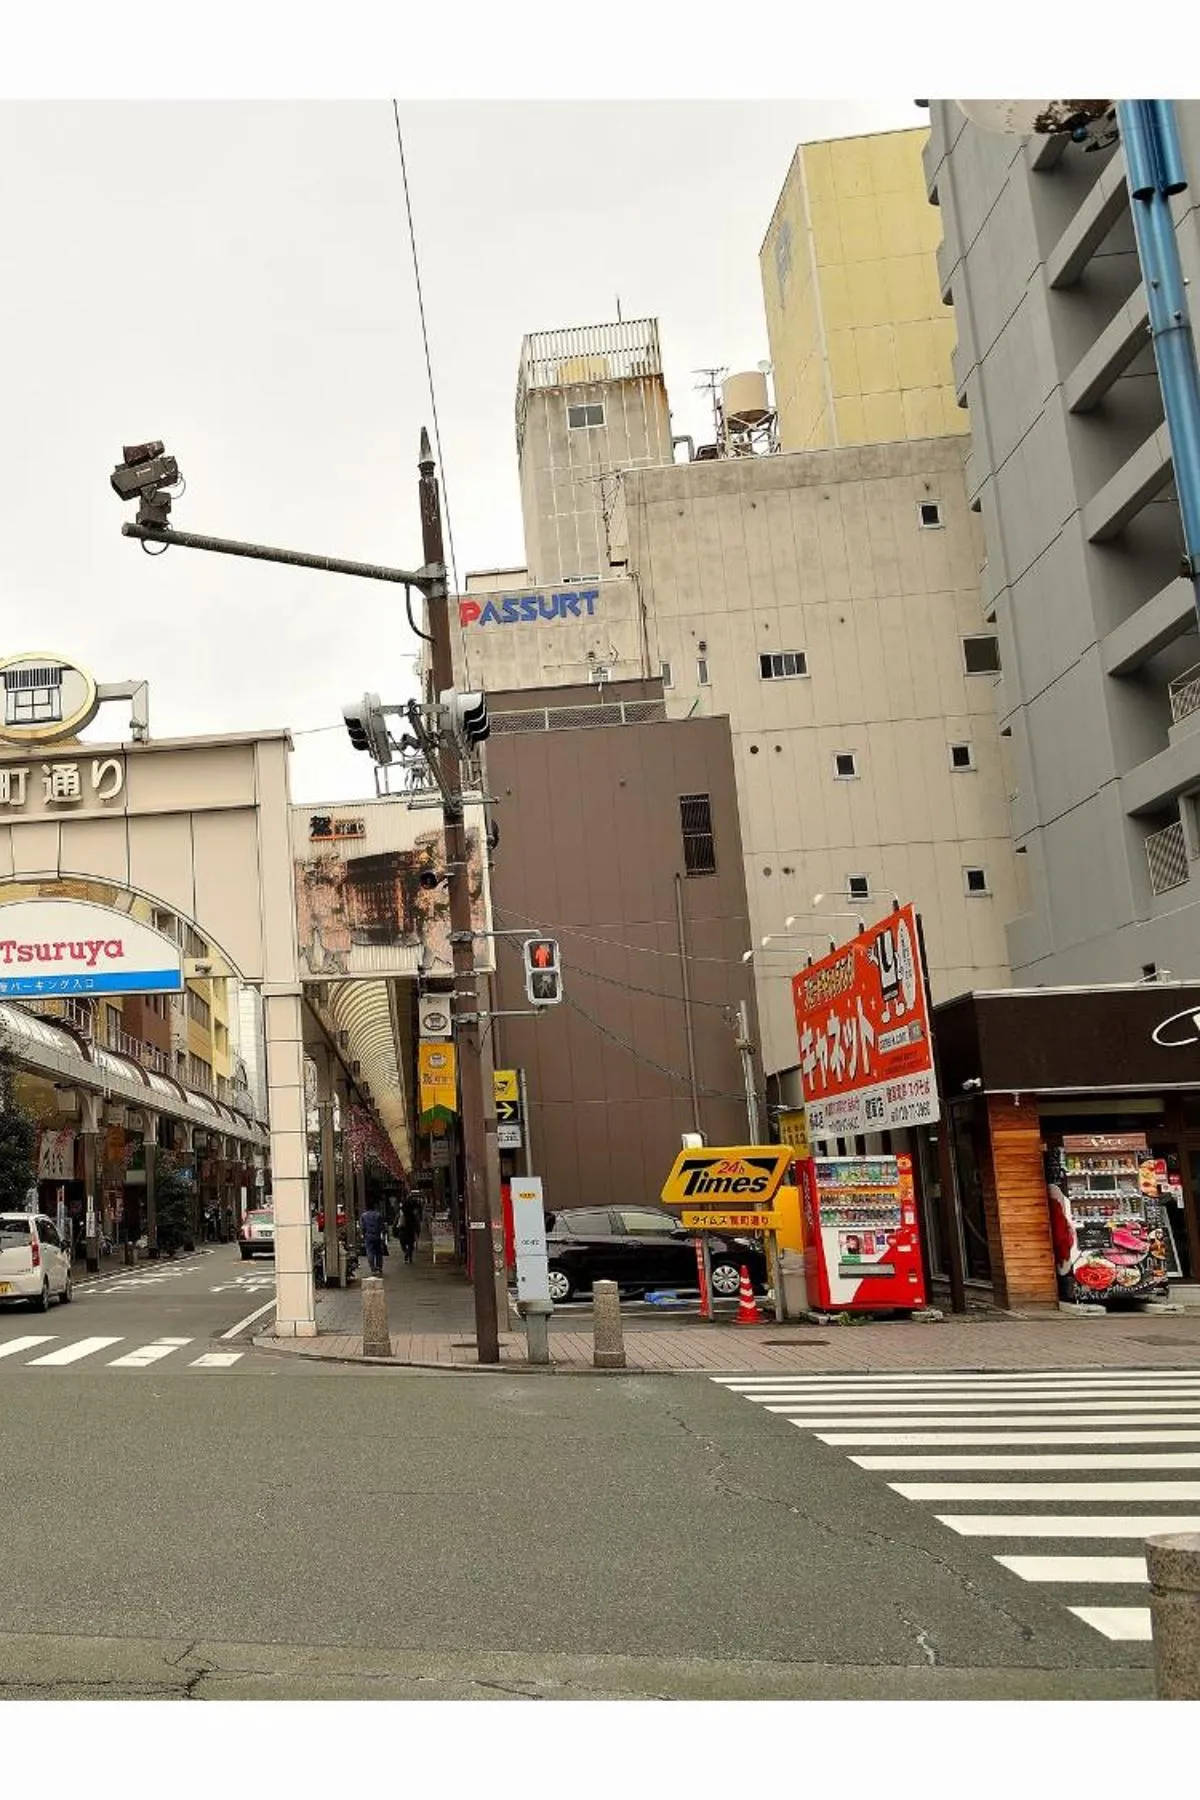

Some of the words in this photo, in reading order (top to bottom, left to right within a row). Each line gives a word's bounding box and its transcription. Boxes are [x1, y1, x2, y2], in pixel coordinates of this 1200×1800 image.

[460, 592, 599, 627] PASSURT
[0, 938, 125, 967] Tsuruya
[683, 1170, 769, 1197] Times
